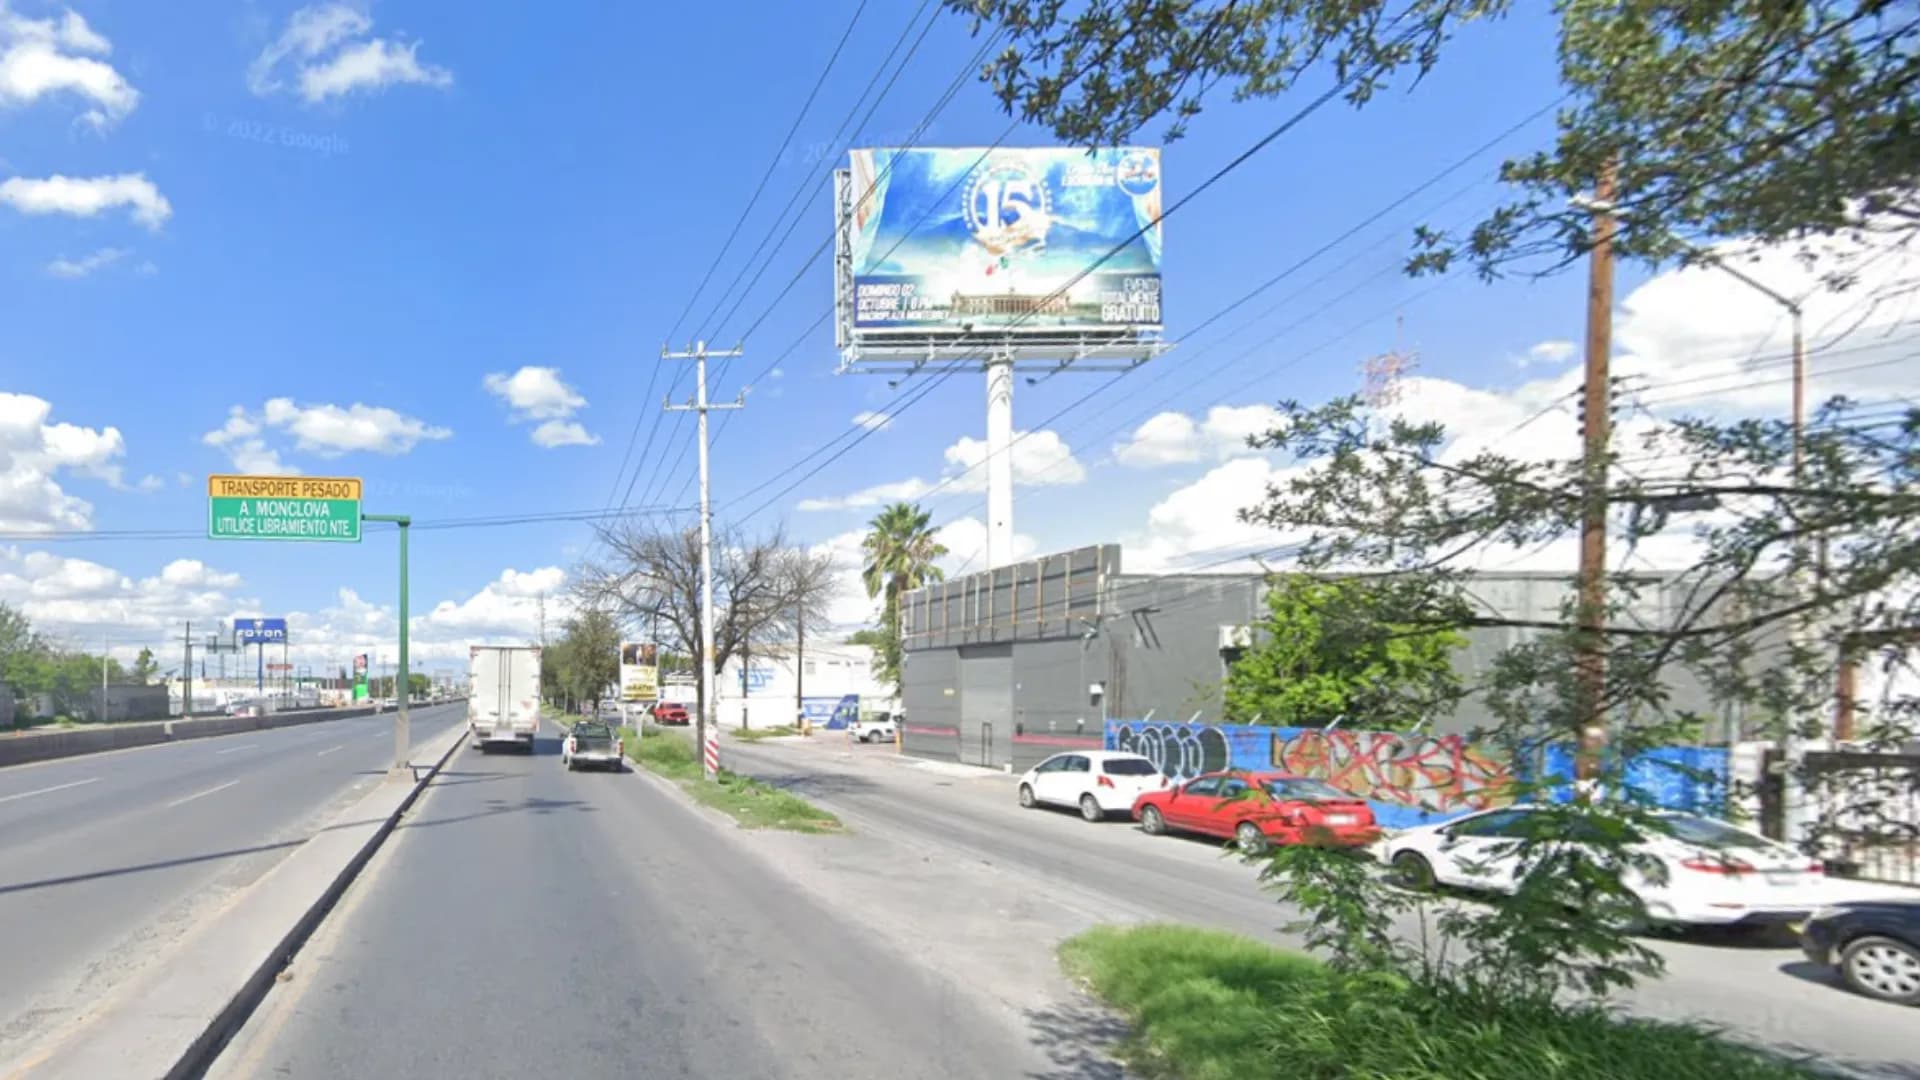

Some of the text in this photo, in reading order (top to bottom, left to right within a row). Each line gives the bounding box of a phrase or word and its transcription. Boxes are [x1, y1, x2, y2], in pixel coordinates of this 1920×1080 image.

[982, 181, 1040, 230] 15
[1102, 303, 1160, 322] GRATUITO
[220, 480, 298, 496] TRANSPORTE
[303, 482, 350, 498] PESADO
[239, 501, 330, 517] A MONCLOVA
[217, 518, 352, 536] UTILICE LIBRAMIENTO NTE.
